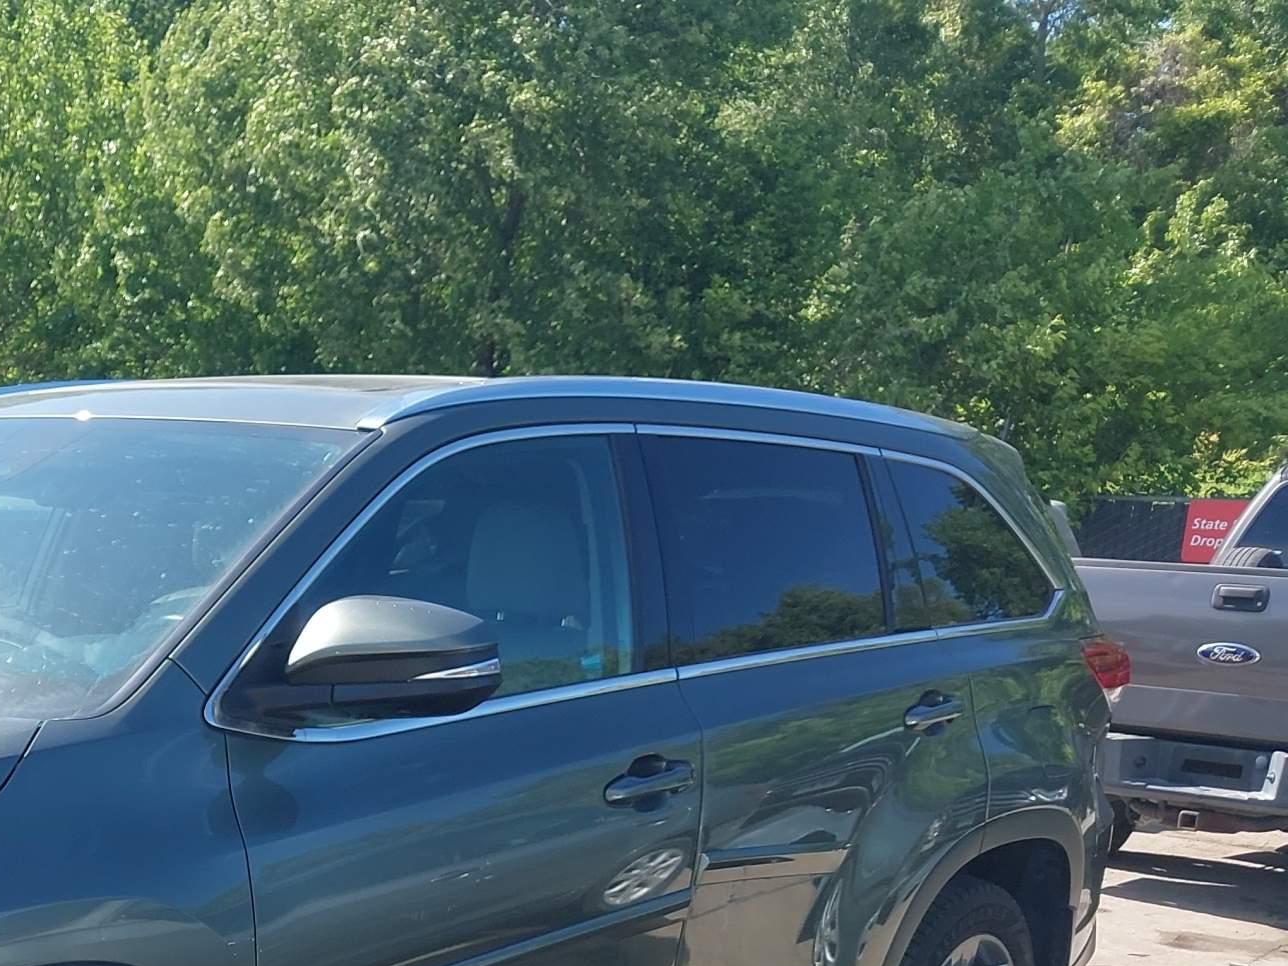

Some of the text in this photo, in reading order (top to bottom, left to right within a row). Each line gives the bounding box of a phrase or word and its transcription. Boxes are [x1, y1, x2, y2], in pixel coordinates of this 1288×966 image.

[1192, 518, 1228, 530] State
[1190, 535, 1224, 550] Drop
[1209, 646, 1246, 662] Ford
